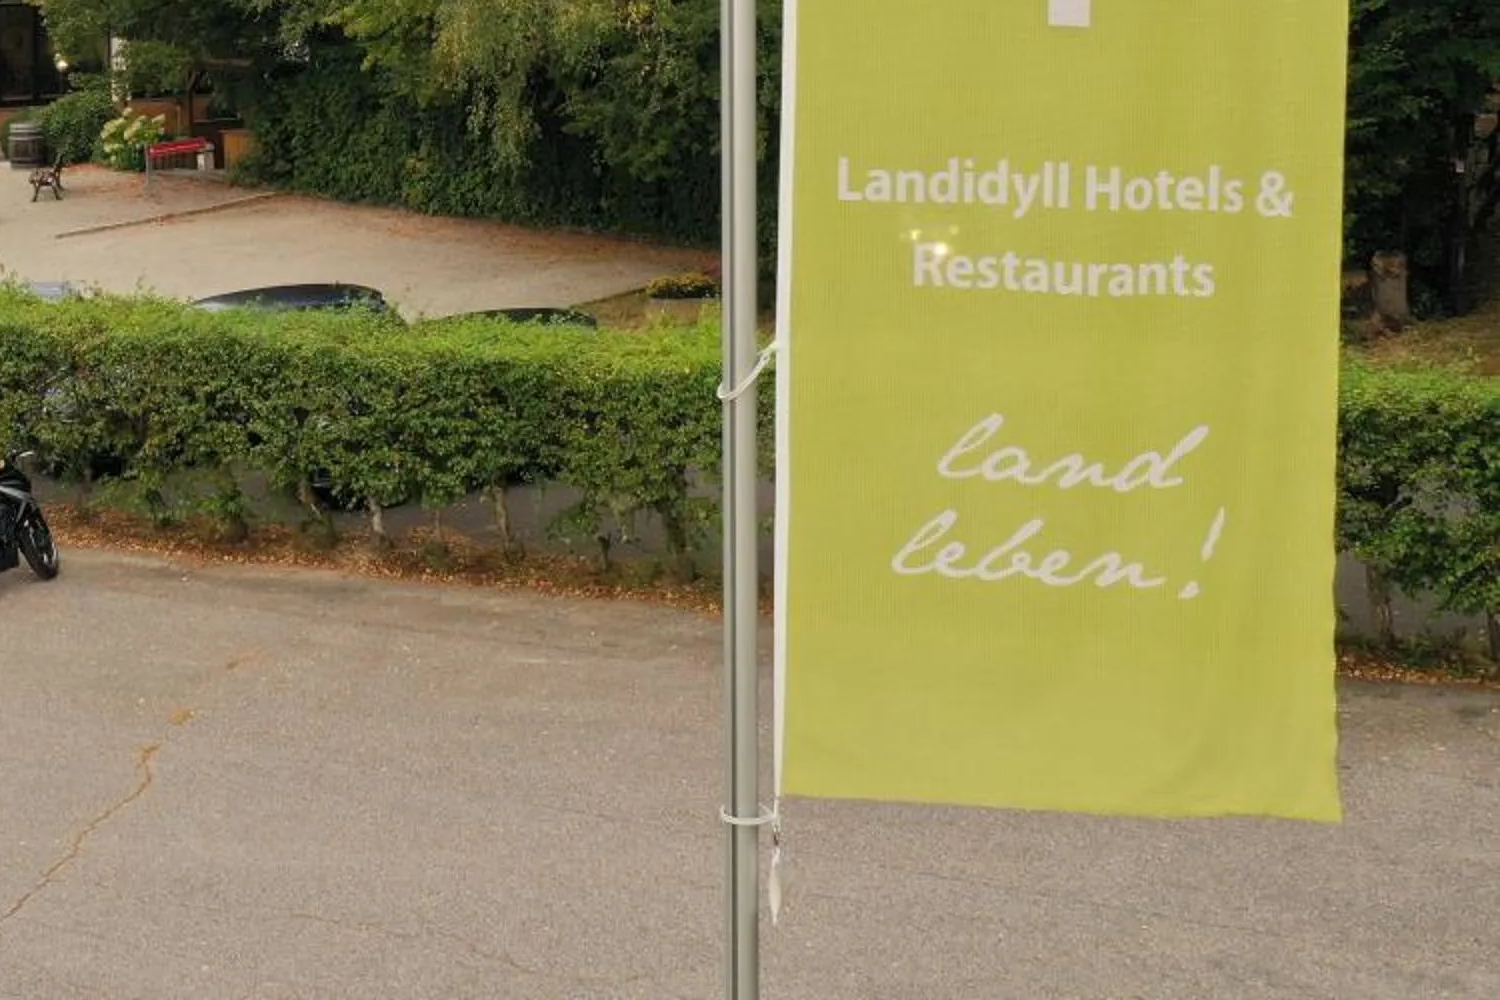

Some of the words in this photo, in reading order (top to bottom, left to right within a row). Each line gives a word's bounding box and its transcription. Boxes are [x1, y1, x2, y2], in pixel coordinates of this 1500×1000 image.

[837, 156, 1070, 218] Landidyll
[1085, 165, 1244, 214] Hotels
[1255, 170, 1295, 217] &
[912, 241, 1216, 298] Restaurants
[937, 412, 1210, 492] land
